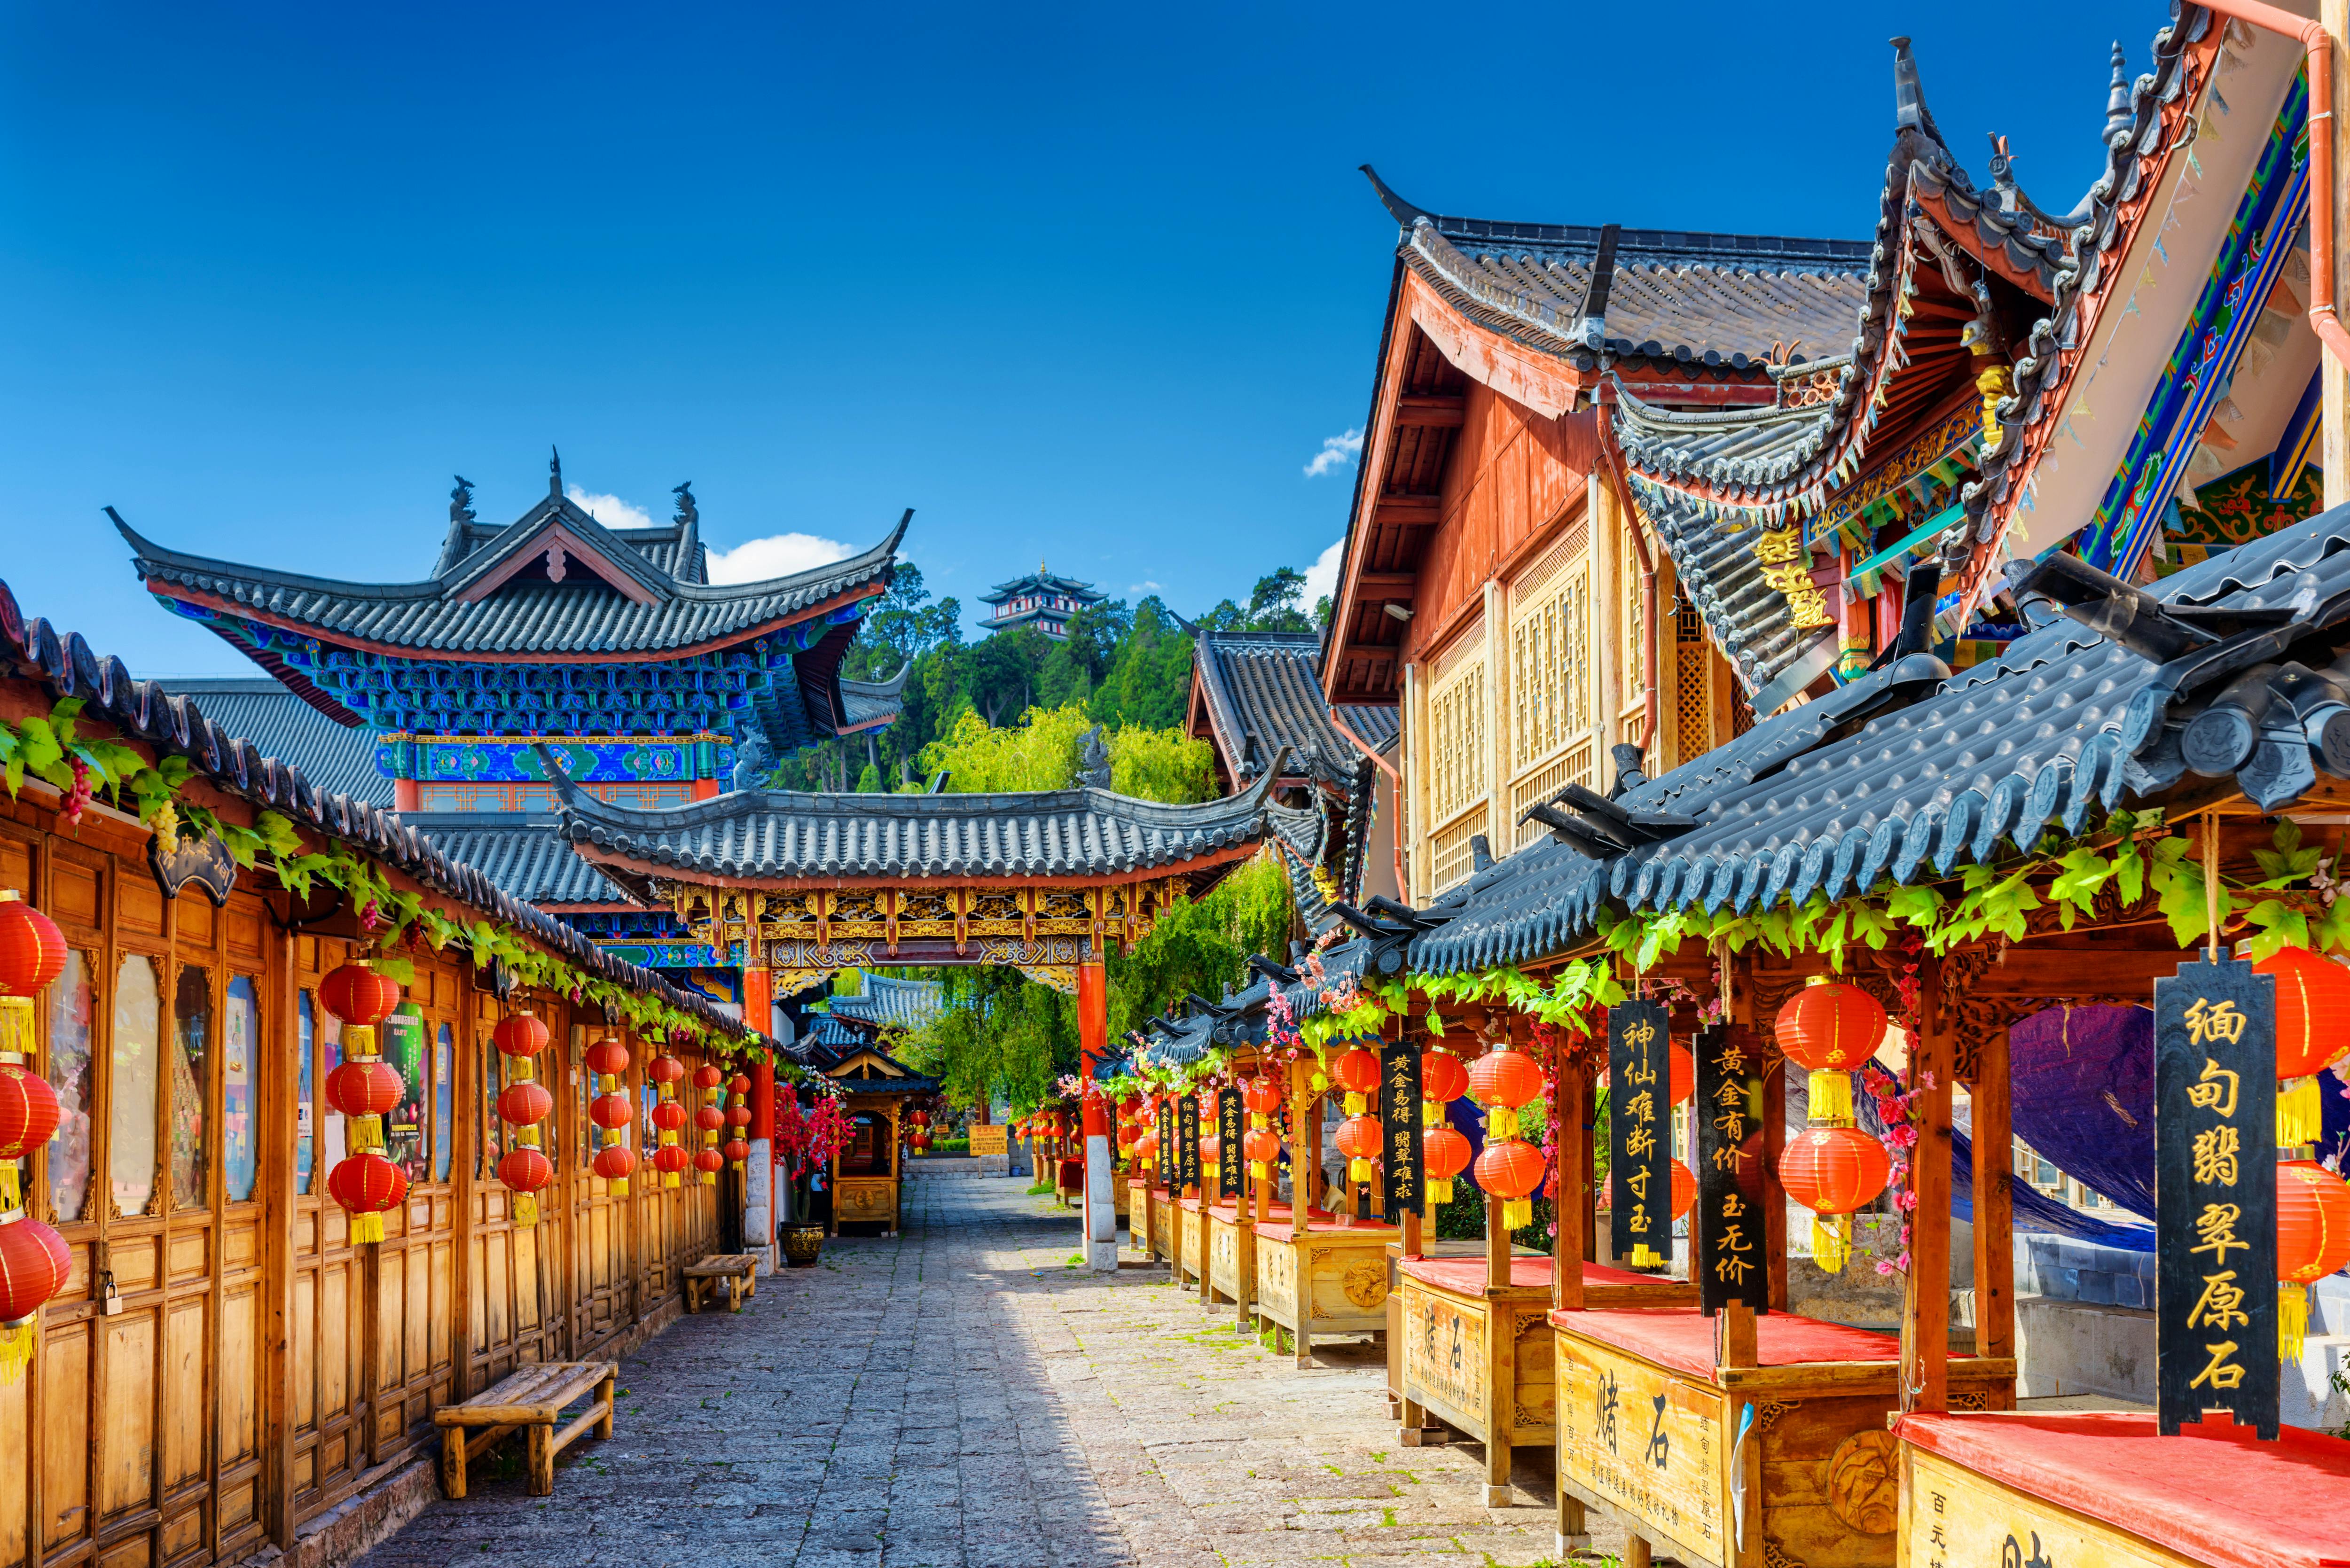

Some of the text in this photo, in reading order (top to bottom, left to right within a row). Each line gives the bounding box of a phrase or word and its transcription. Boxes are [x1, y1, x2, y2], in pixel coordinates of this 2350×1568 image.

[1160, 1107, 1169, 1139] 黄金易得
[1183, 1101, 1195, 1178] 缅甸翡翠原石
[1223, 1096, 1238, 1186] 黄金易得 翡翠难求
[1388, 1054, 1414, 1199] 黄金易得 翡翠难求
[1622, 1021, 1656, 1233] 神仙难断寸玉
[1711, 1045, 1755, 1286] 黄金有价 玉无价
[2183, 998, 2250, 1389] 缅甸翡翠原石
[1567, 1357, 1575, 1462] 百元博百万
[1595, 1368, 1669, 1470] 赌石
[1700, 1414, 1712, 1540] 缅甸翡翠原石
